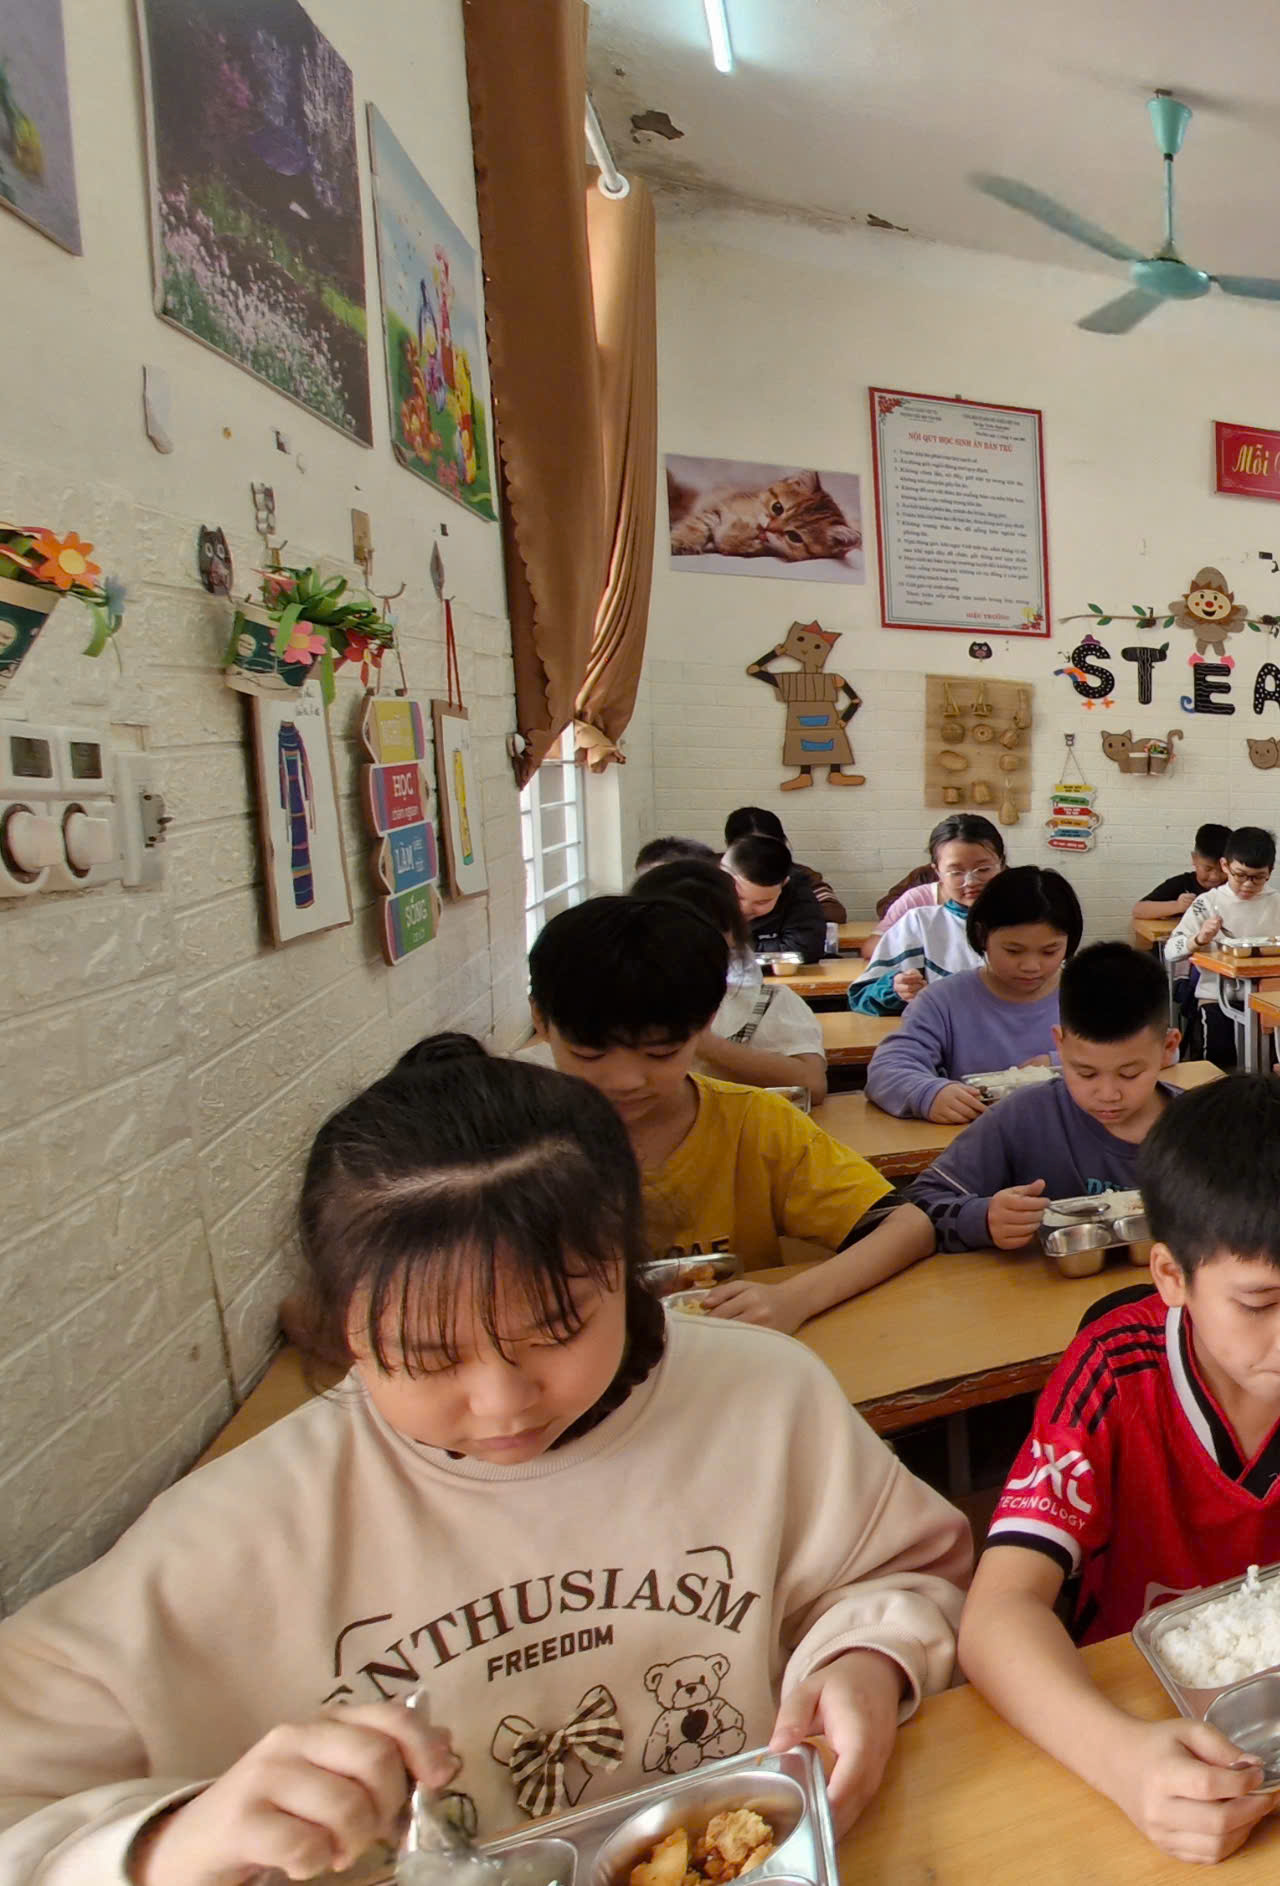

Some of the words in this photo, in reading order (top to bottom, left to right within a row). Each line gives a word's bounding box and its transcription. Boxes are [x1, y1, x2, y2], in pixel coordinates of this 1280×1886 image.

[1232, 444, 1268, 477] Mỗi
[392, 772, 414, 800] HỌC
[487, 1624, 614, 1682] FREEDOM
